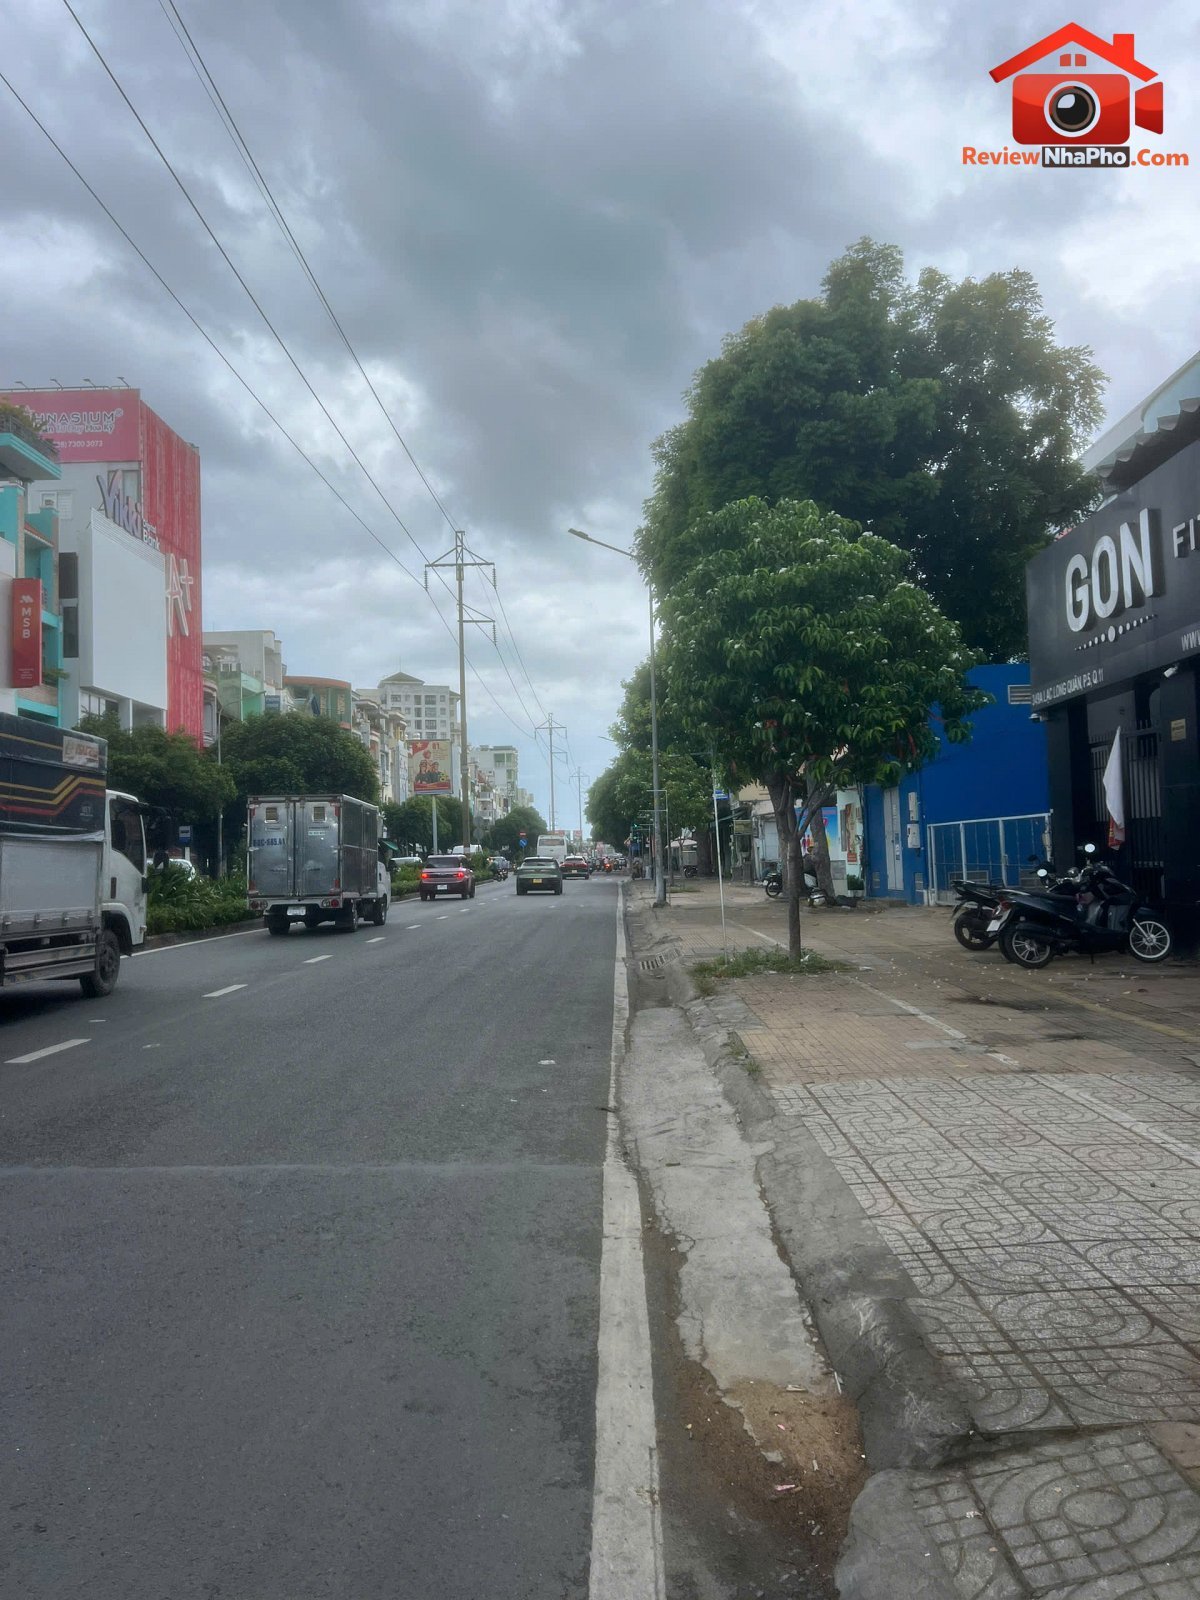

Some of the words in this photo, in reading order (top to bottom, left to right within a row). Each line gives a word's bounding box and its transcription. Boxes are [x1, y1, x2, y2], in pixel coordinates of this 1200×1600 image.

[96, 469, 144, 541] Vikki
[143, 528, 161, 552] Bank
[1065, 507, 1155, 633] GON
[21, 607, 33, 639] MSB
[1053, 682, 1067, 699] LONG
